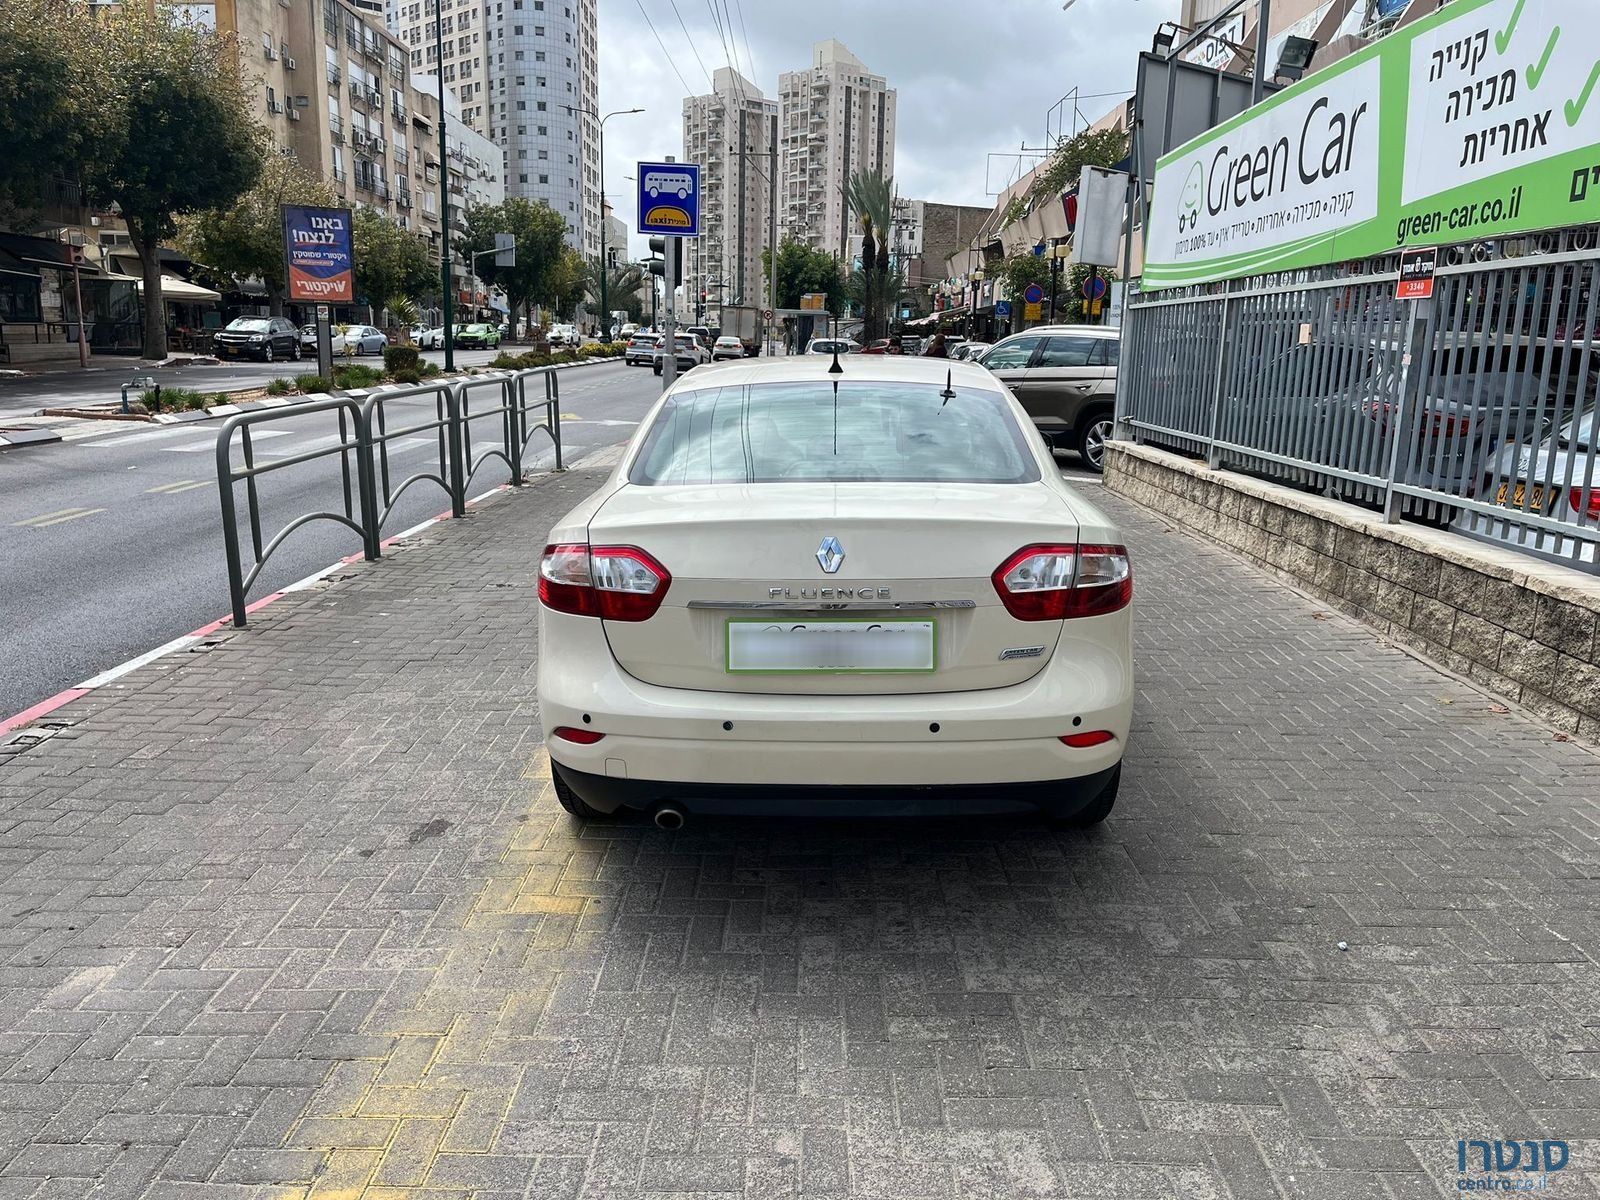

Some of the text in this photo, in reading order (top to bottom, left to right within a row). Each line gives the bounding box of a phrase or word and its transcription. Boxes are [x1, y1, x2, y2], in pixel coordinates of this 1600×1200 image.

[1429, 28, 1489, 83] קנייה
[1444, 68, 1517, 124] מכירה
[1459, 109, 1552, 168] אחריות
[1207, 96, 1368, 217] Green Car
[1292, 200, 1321, 224] מכירה
[1328, 190, 1354, 217] קניה
[1396, 185, 1523, 245] green-car.co.il
[311, 217, 344, 230] באנו
[1255, 210, 1287, 234] אחריות
[292, 229, 335, 244] לנצח!
[1189, 234, 1206, 252] 100%
[322, 252, 347, 261] ויקטורי
[768, 586, 892, 599] FLUENCE
